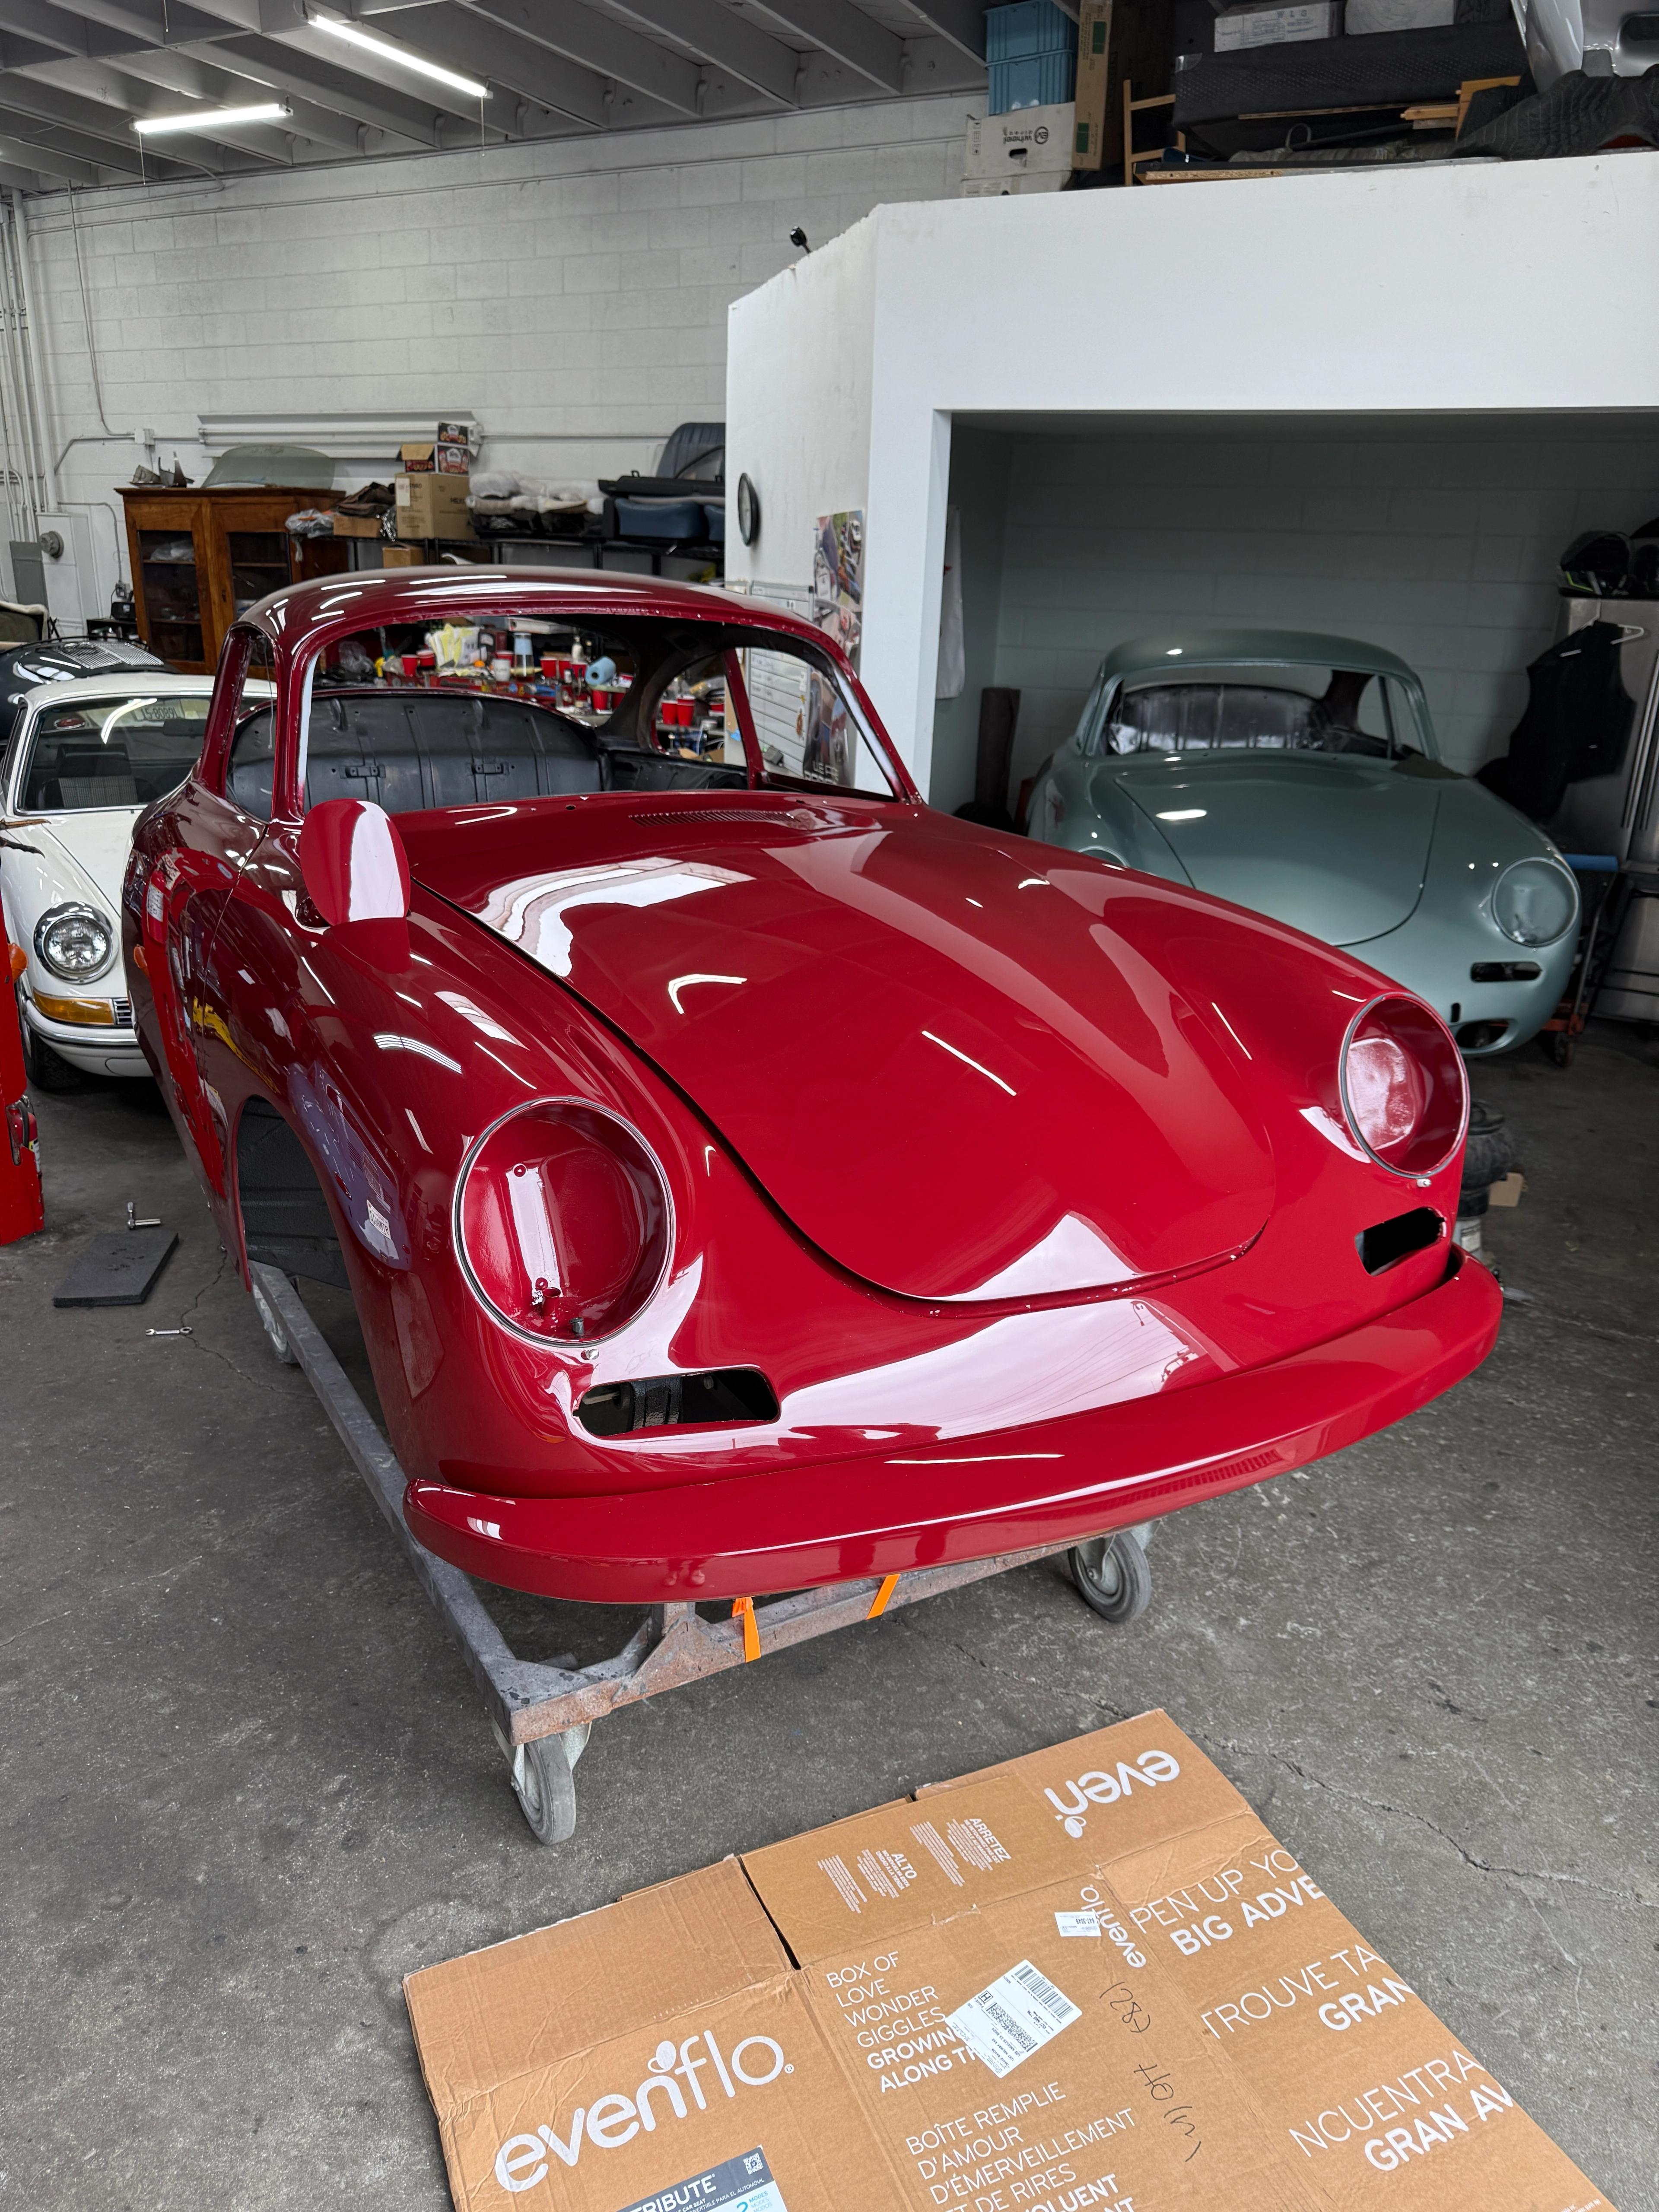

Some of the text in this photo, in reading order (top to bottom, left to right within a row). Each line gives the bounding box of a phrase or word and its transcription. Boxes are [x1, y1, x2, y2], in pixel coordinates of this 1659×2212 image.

[969, 1818, 1012, 1861] ARRETEZ
[891, 1853, 918, 1879] ALTO
[1198, 1869, 1244, 1902] UP
[1170, 1875, 1326, 1956] BIG ADVE
[826, 1951, 900, 1988] BOX OF
[1330, 1945, 1386, 1976] TA
[835, 1978, 890, 2008] LOVE
[844, 1985, 939, 2027] WONDER
[856, 2007, 945, 2048] GIGGLES
[866, 2027, 956, 2070] GROWIN
[880, 2053, 953, 2093] ALONG
[905, 2081, 1067, 2156] BOÎTE REMPLIE
[1288, 2050, 1486, 2158] NCUENTRA
[917, 2126, 1024, 2180] D'AMOUR
[929, 2107, 1136, 2205] D'ÉMERVEILLEMENT
[1364, 2103, 1469, 2171] GRAN
[692, 2198, 706, 2208] SEAT
[715, 2194, 730, 2204] PARA
[749, 2191, 769, 2202] MODES
[975, 2189, 1010, 2212] DE
[1009, 2163, 1077, 2204] RIRES
